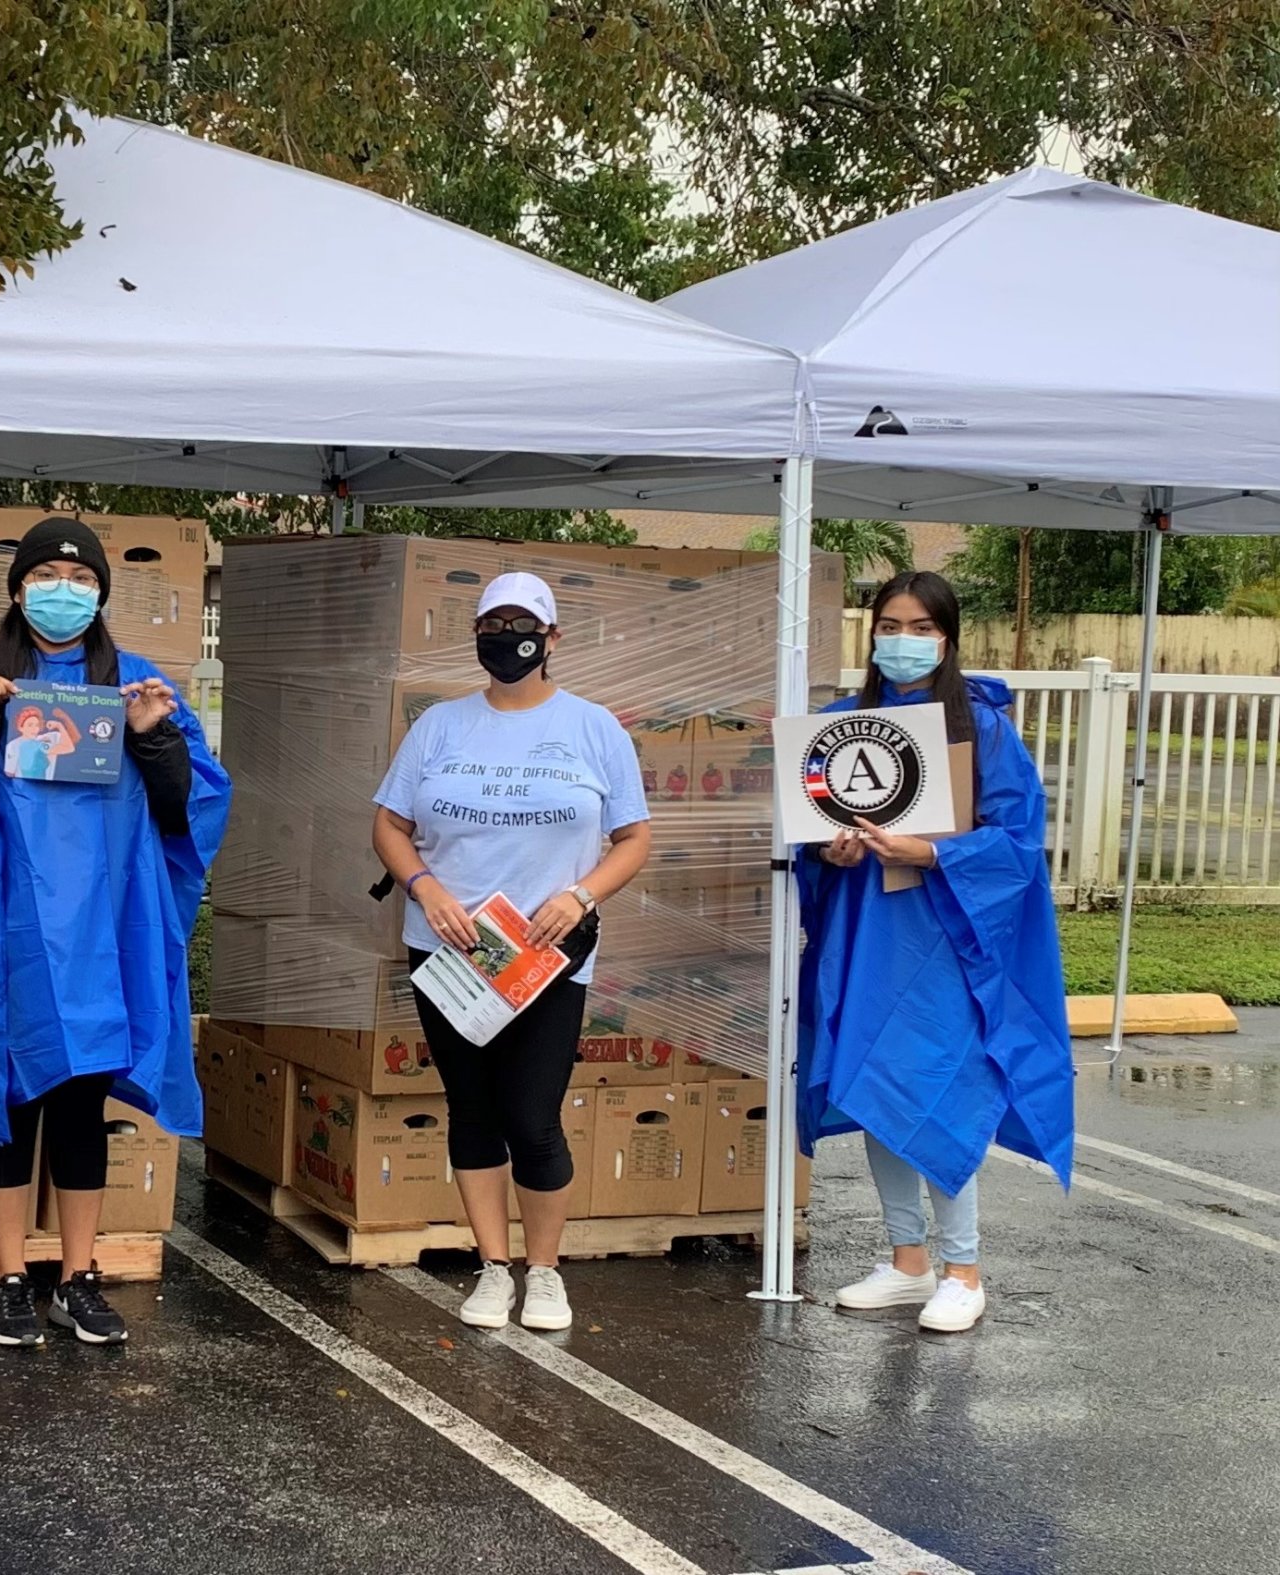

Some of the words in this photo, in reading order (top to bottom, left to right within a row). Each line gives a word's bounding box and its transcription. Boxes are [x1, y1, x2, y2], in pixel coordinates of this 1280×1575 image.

[178, 526, 184, 542] 1
[185, 527, 199, 543] BU.
[51, 682, 75, 693] Thanks
[76, 685, 88, 693] for
[16, 689, 54, 703] Getting
[57, 691, 89, 706] Things
[814, 720, 910, 756] AMERICORPS
[441, 762, 458, 775] WE
[460, 763, 487, 776] CAN
[522, 767, 582, 783] DIFFICULT
[842, 747, 889, 793] A
[481, 783, 502, 797] WE
[504, 784, 532, 797] ARE
[431, 798, 488, 825] CENTRO
[492, 806, 577, 827] CAMPESINO
